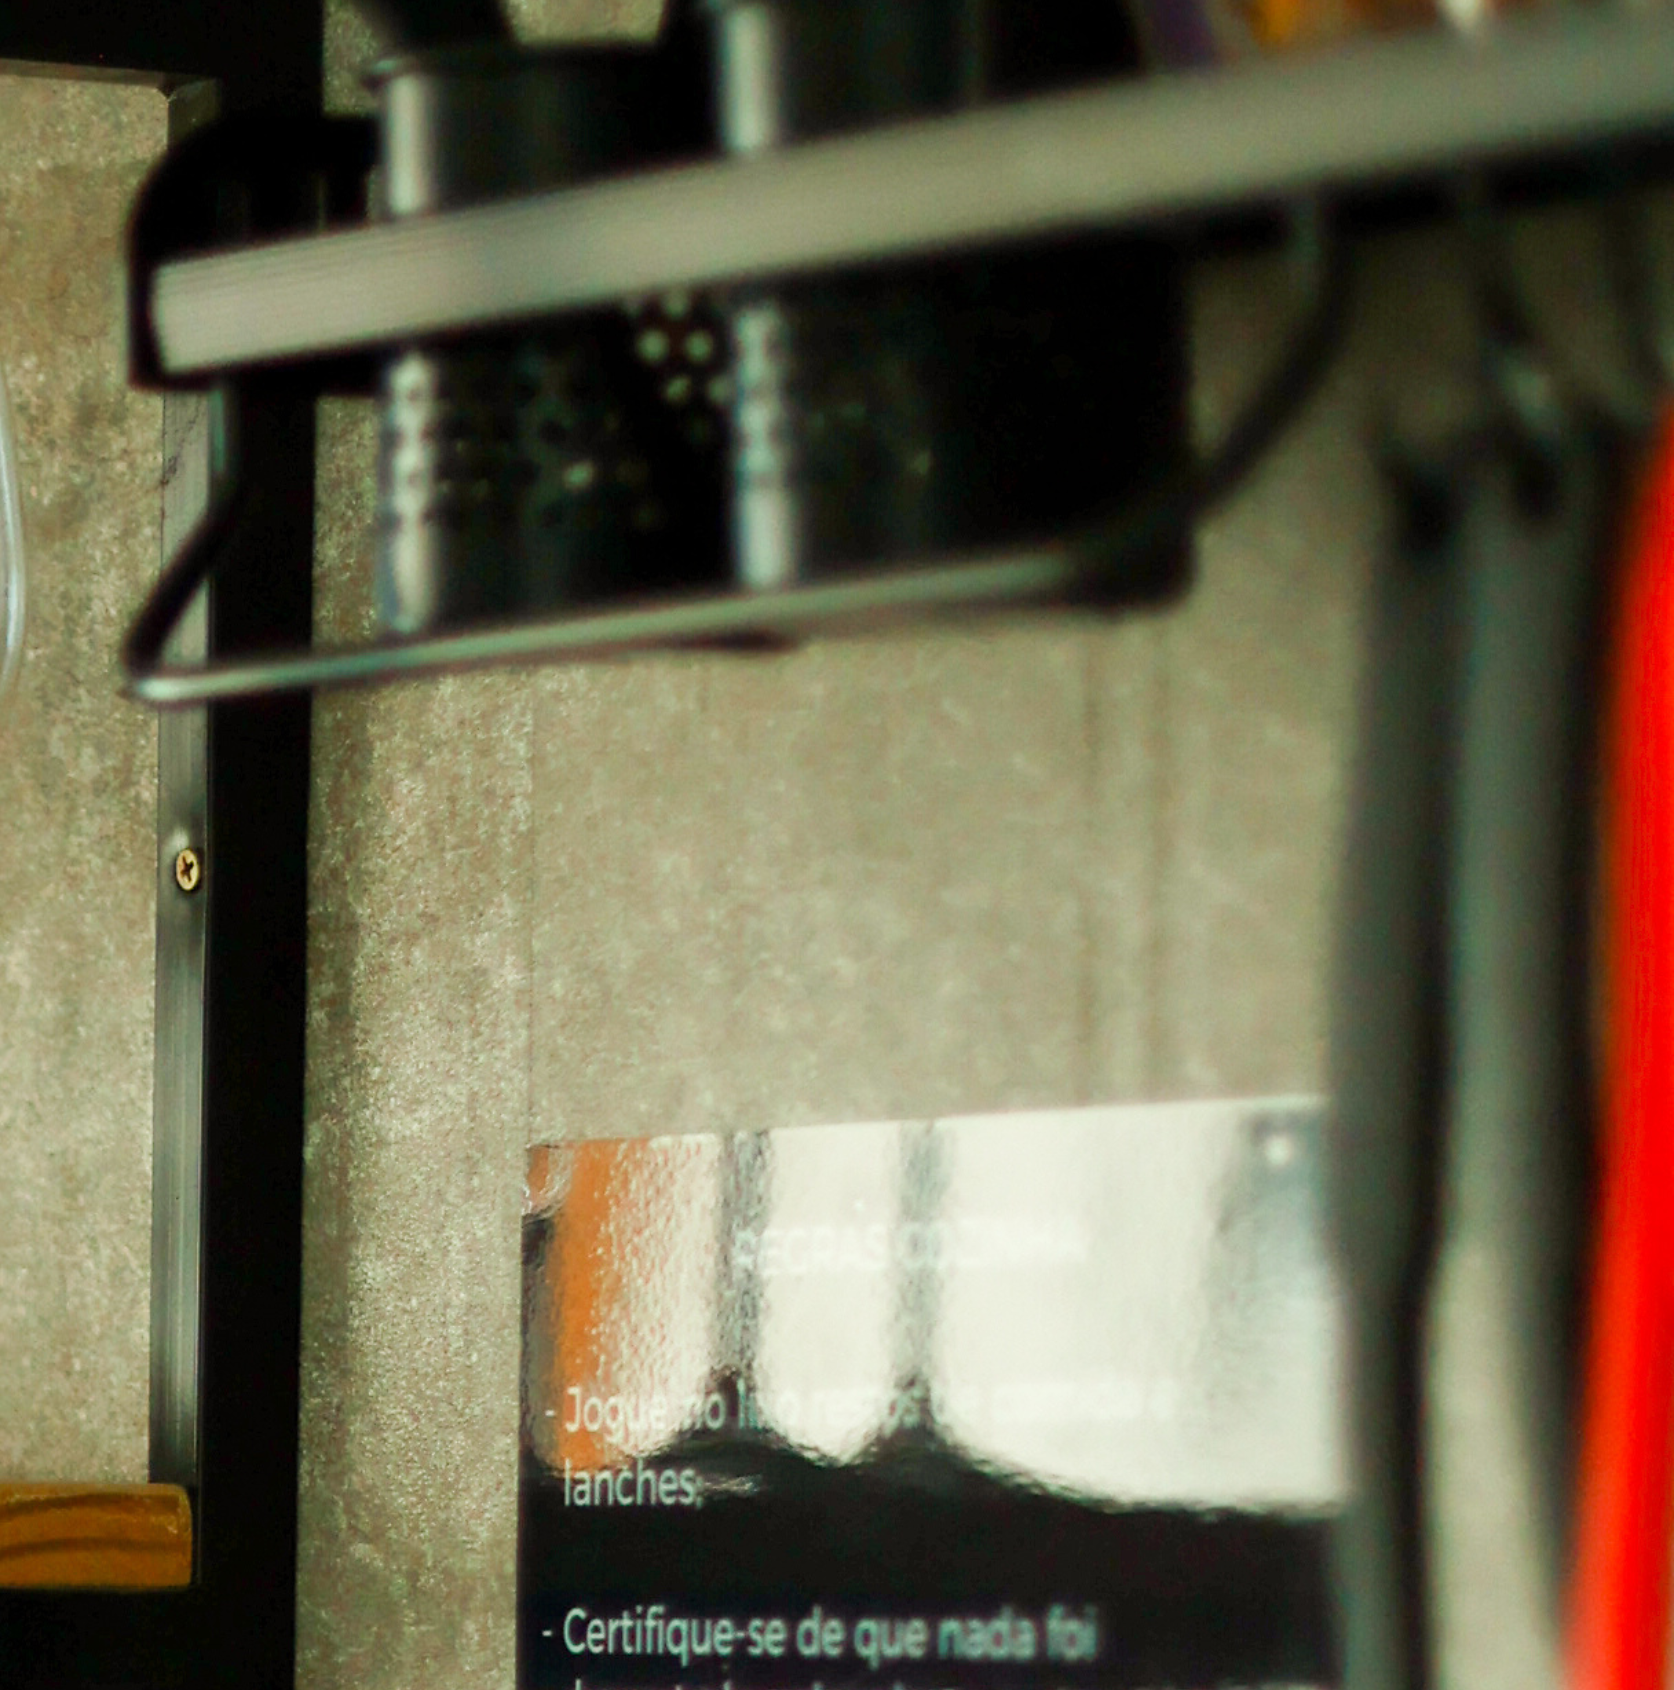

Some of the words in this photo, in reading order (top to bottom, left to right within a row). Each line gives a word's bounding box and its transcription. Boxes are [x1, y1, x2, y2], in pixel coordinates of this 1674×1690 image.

[564, 1385, 668, 1449] Jogue
[563, 1605, 786, 1668] Certifique-se
[796, 1604, 845, 1657] de
[854, 1616, 928, 1671] que
[937, 1607, 1038, 1660] nada
[1046, 1604, 1099, 1658] foi
